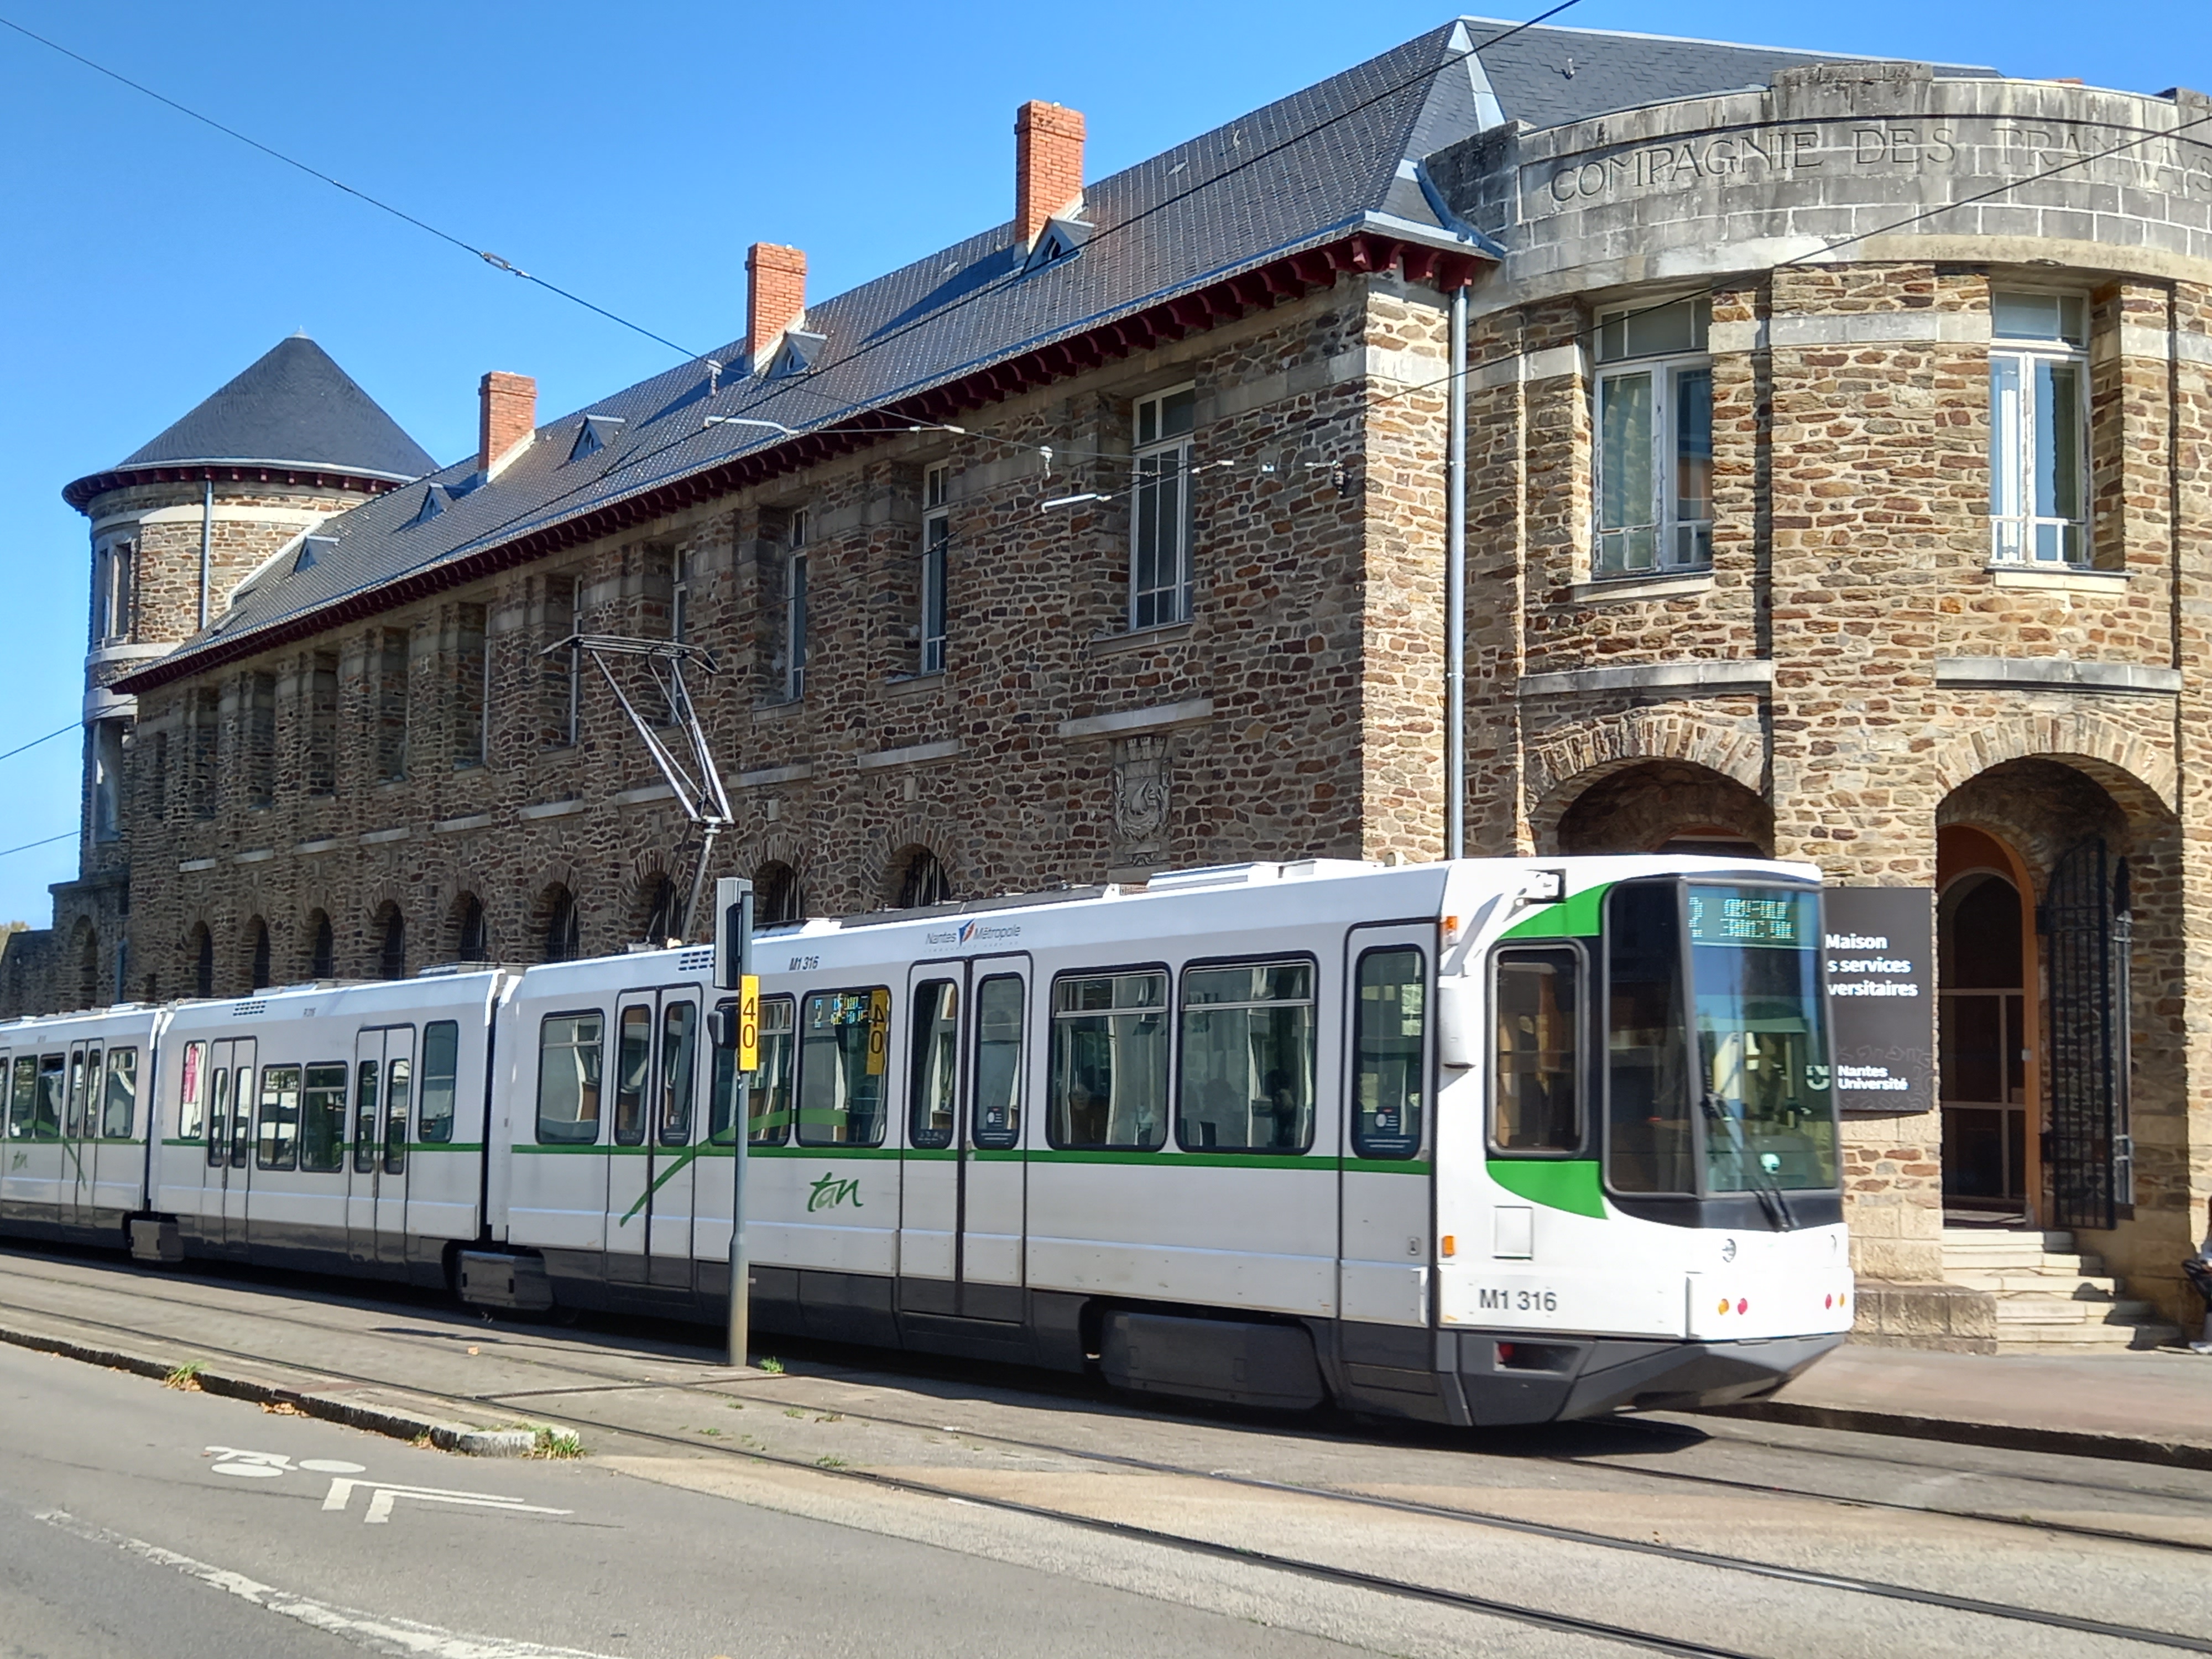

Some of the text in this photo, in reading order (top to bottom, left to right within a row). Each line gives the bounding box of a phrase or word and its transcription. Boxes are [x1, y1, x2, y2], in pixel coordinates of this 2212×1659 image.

[1550, 132, 1824, 203] COMPAGNIE
[1853, 128, 1955, 164] DES
[926, 924, 1021, 945] Nantes Métropole
[1825, 933, 1888, 950] Maison
[789, 956, 820, 971] M1 316
[1839, 956, 1911, 973] services
[1827, 979, 1918, 997] versitaires
[1838, 1065, 1888, 1078] Nantes
[1838, 1077, 1908, 1091] Université
[807, 1172, 864, 1213] tan
[1480, 1288, 1557, 1312] M1 316
